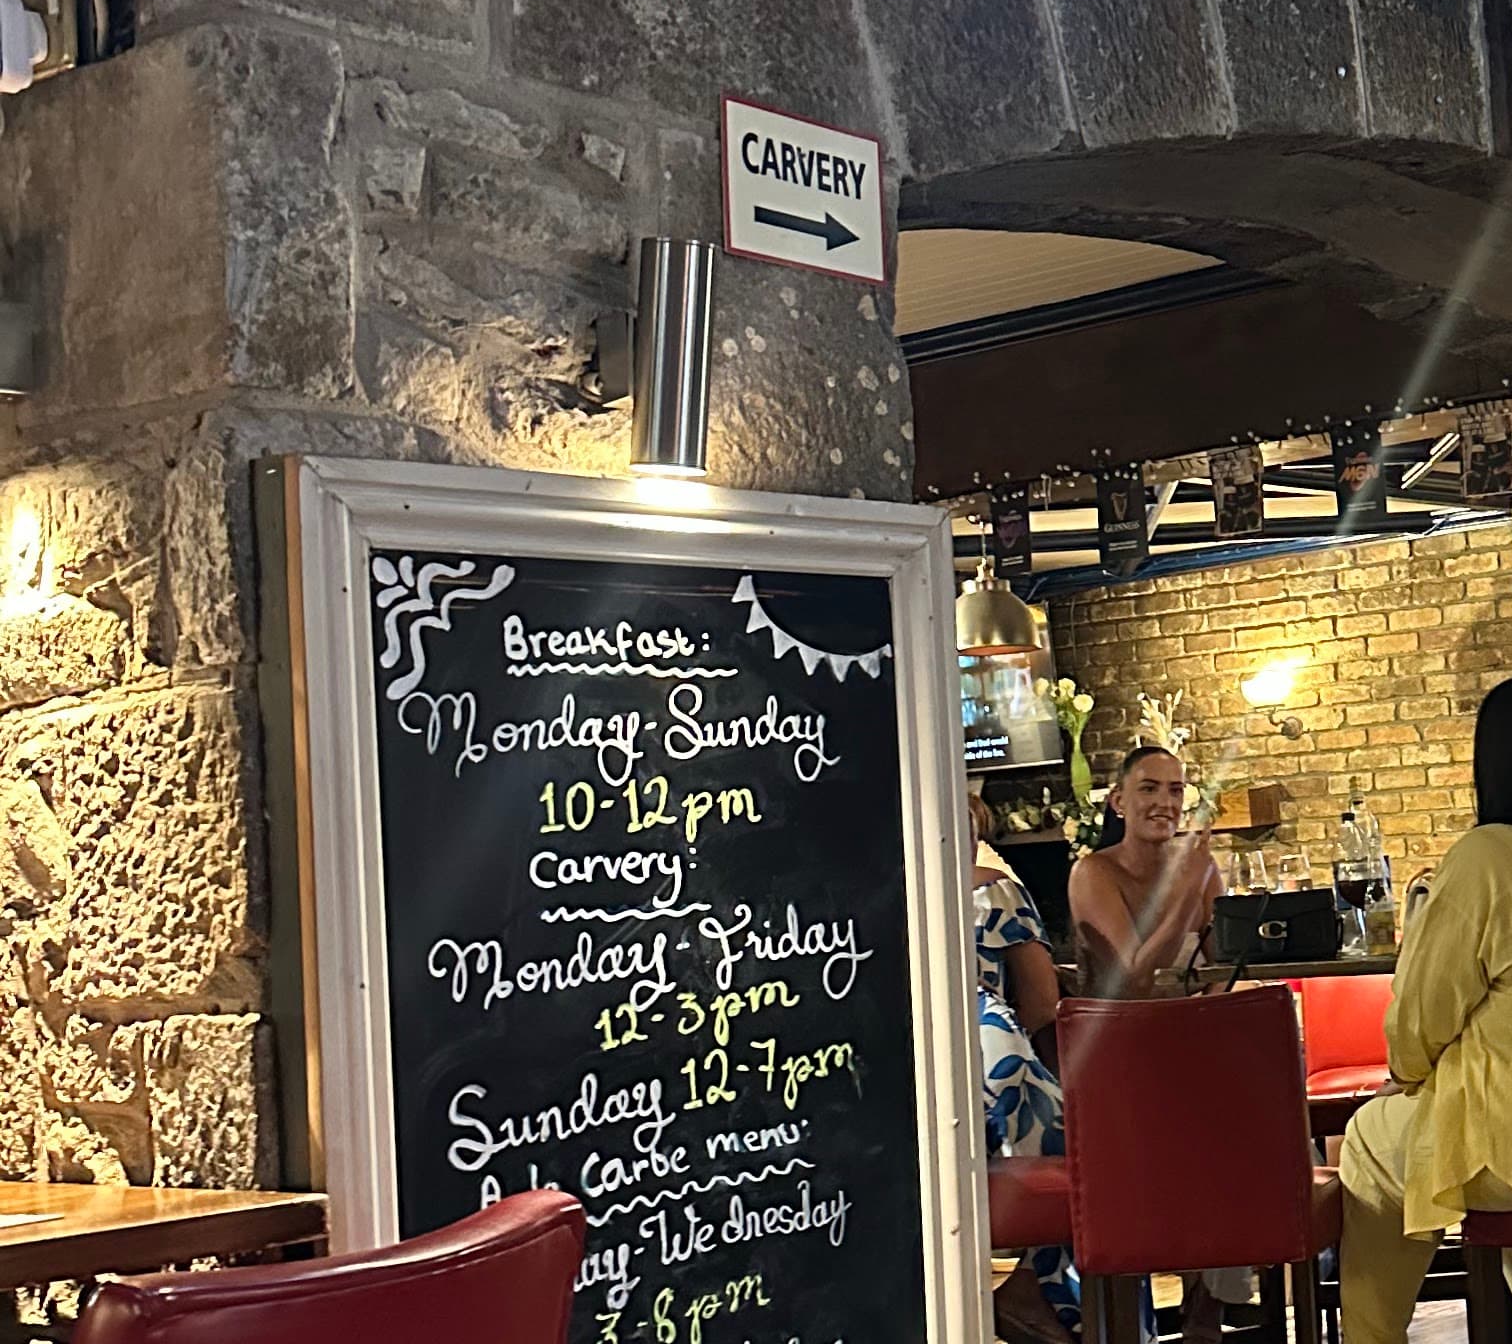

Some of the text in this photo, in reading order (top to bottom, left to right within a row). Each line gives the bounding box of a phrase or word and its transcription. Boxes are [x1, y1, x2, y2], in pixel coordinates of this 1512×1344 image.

[741, 132, 866, 200] CARVERY
[503, 615, 711, 660] Breakfast:
[448, 1072, 677, 1172] Sunday
[573, 1180, 852, 1311] ay-Wednesday
